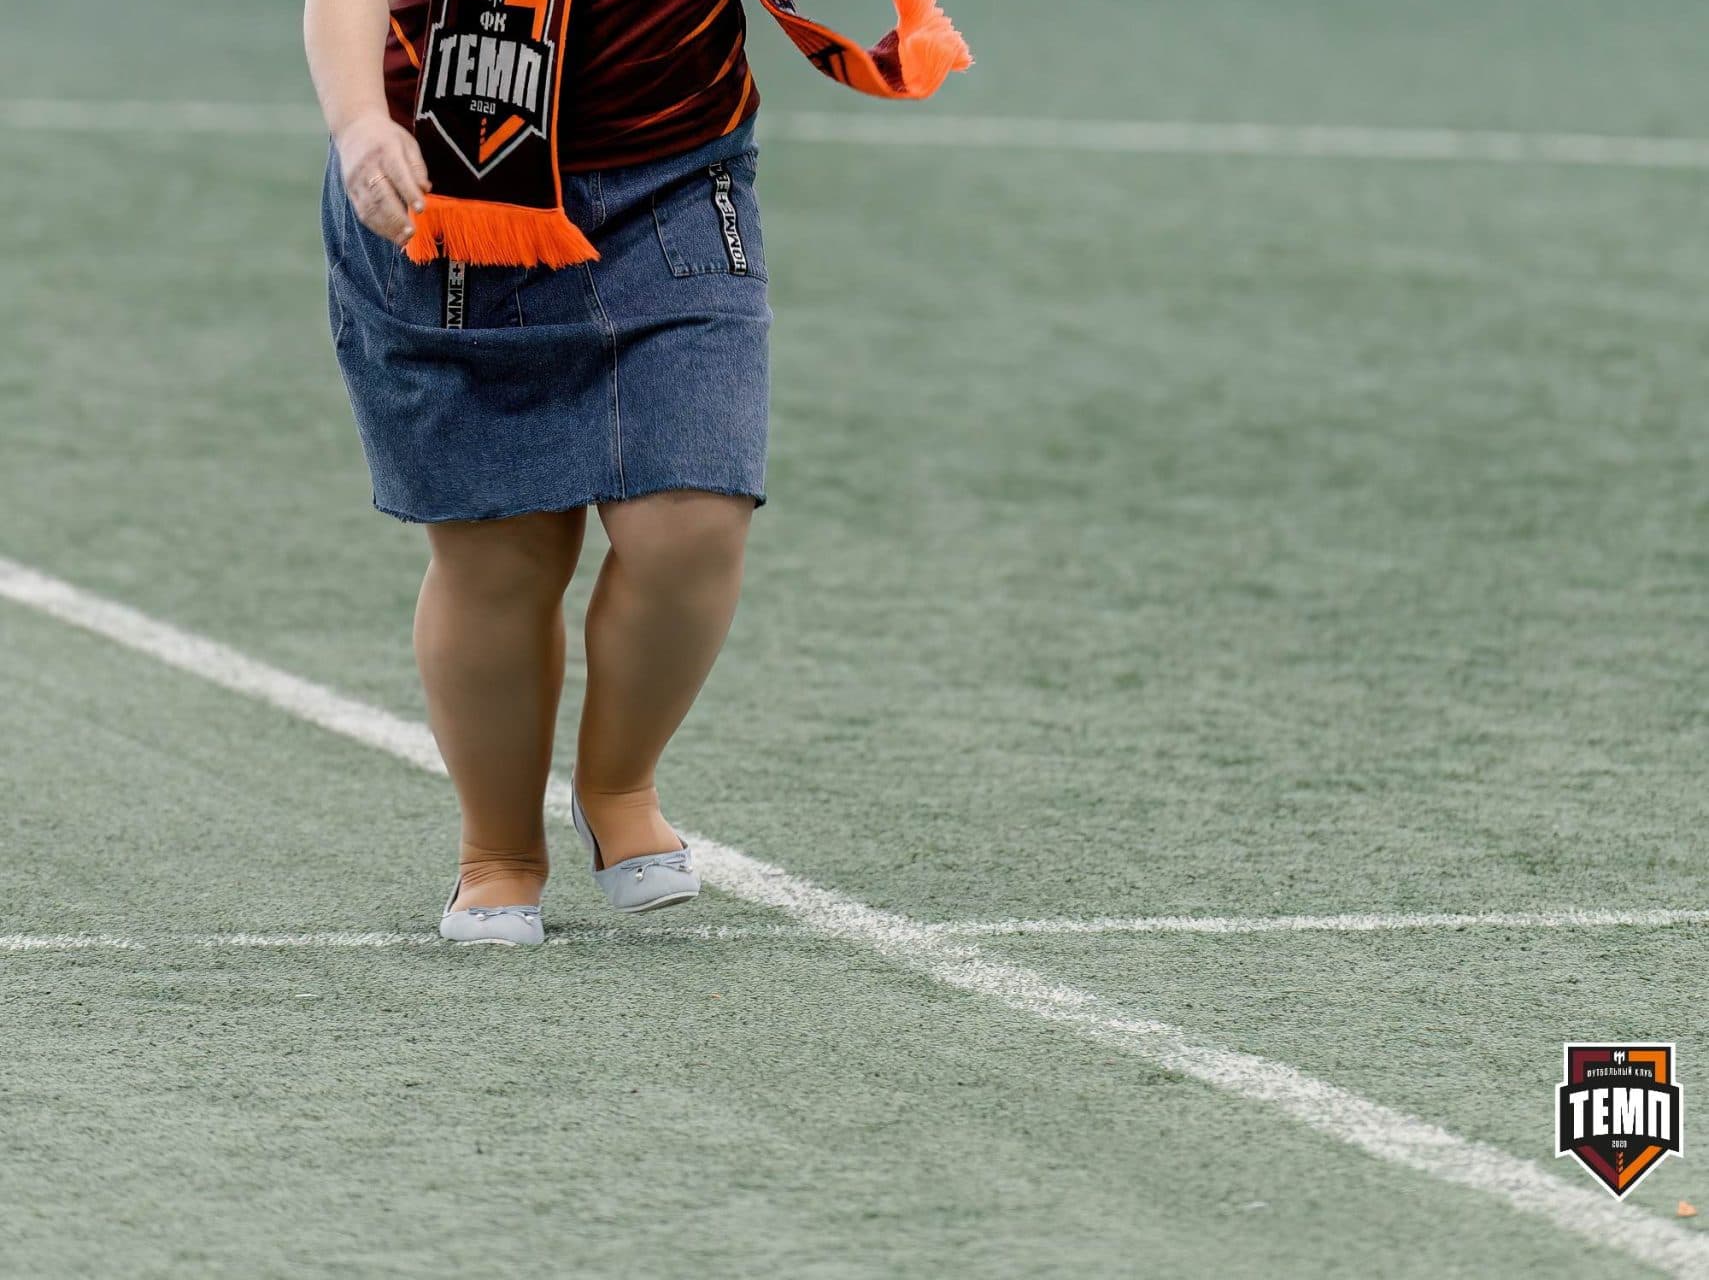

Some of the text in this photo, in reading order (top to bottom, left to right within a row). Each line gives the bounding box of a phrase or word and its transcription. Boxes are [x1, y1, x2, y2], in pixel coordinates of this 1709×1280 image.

[479, 11, 507, 32] ФК
[435, 33, 542, 113] ТЕМП
[469, 99, 496, 115] 2020
